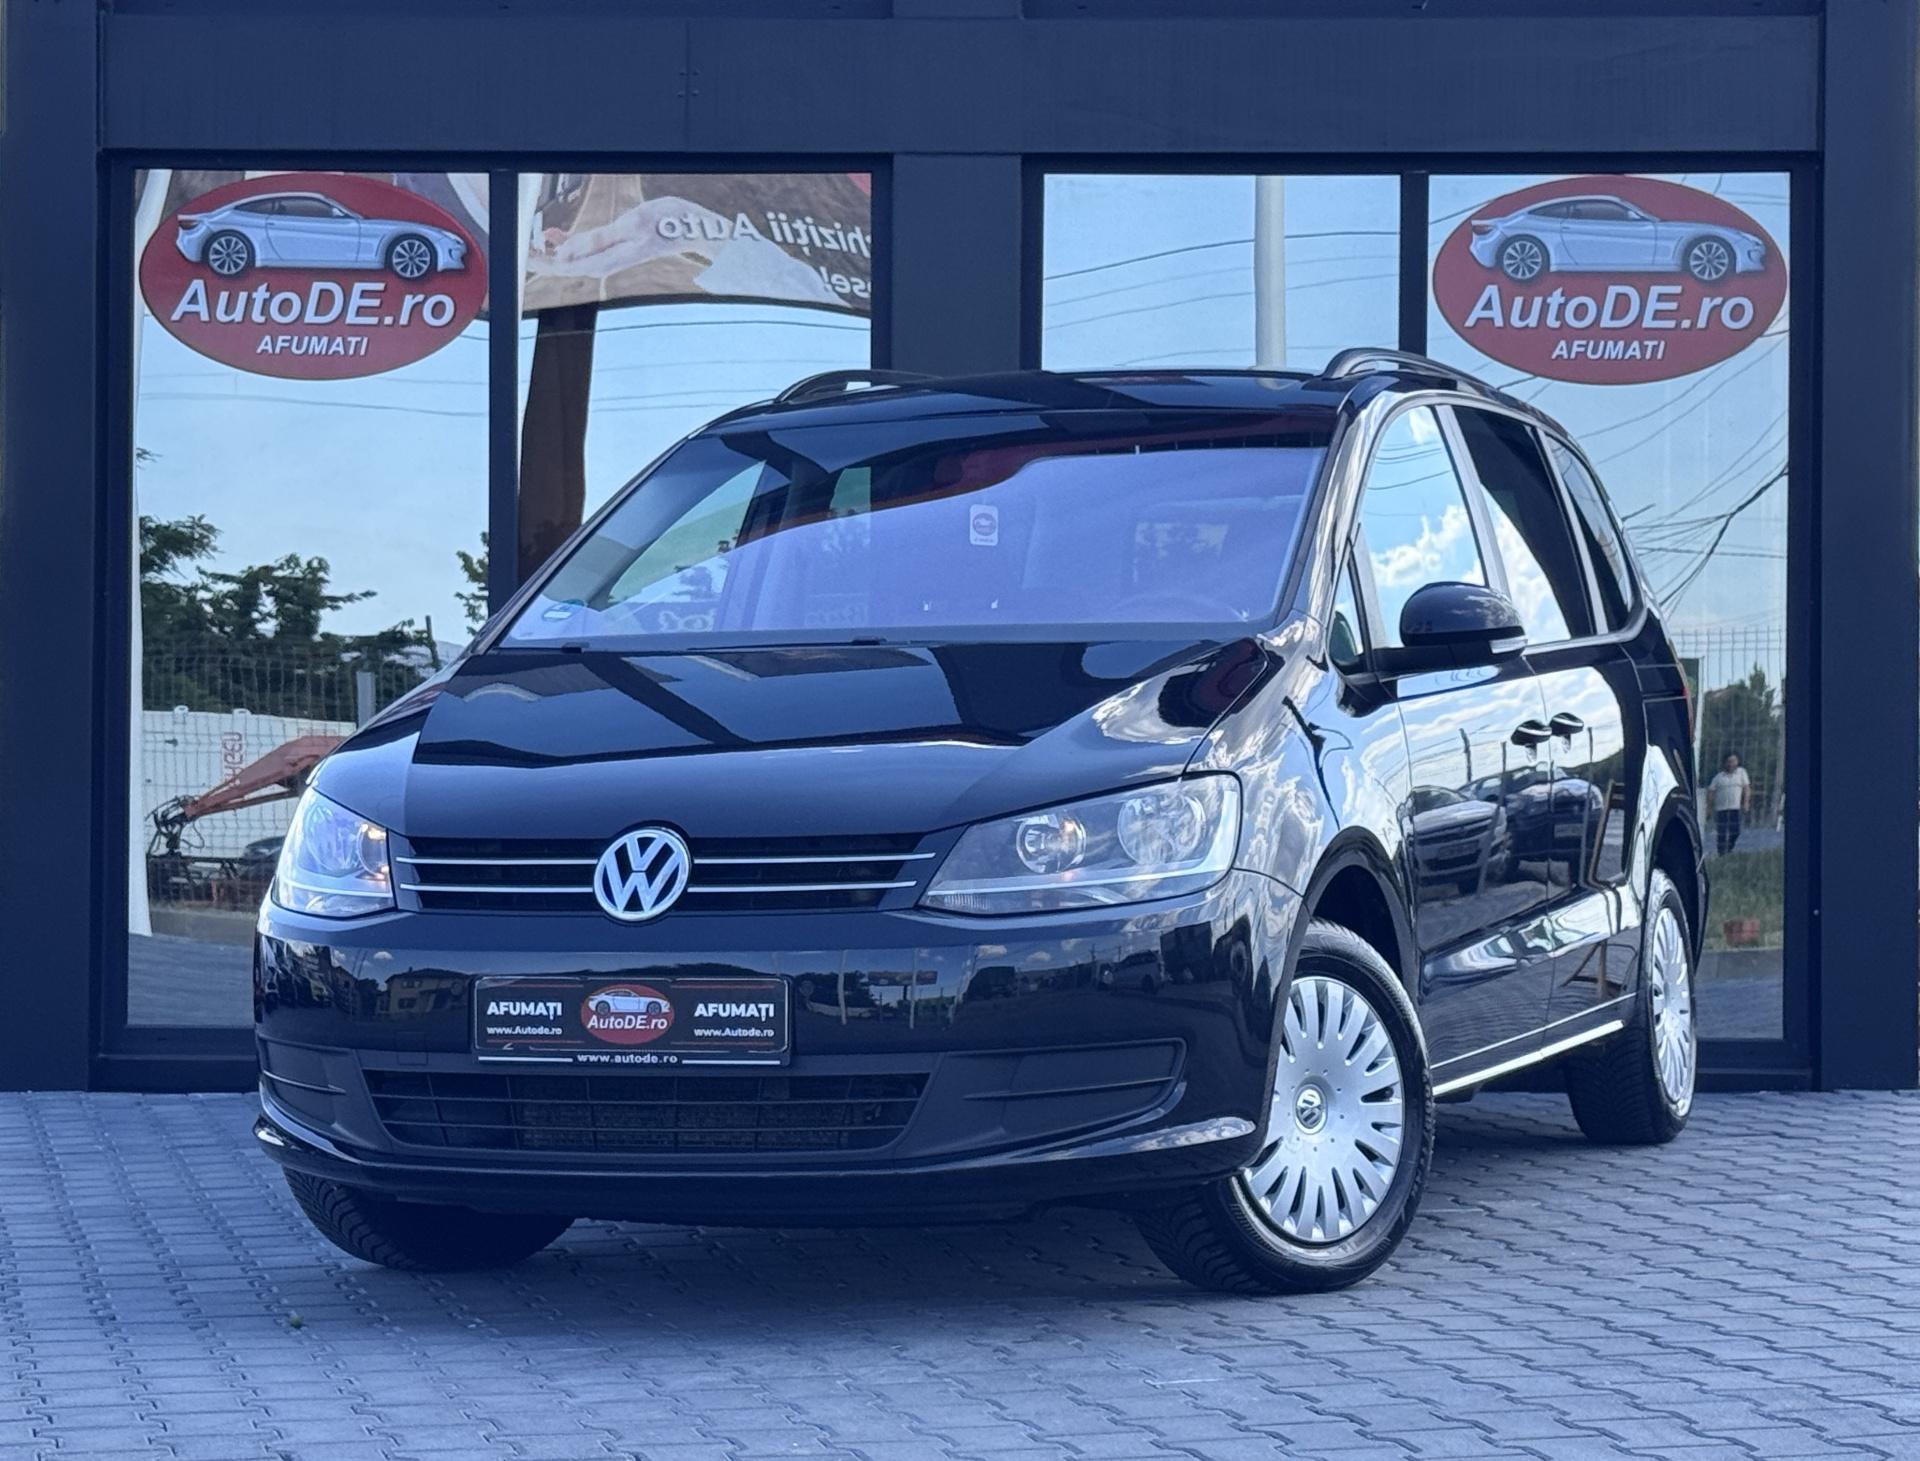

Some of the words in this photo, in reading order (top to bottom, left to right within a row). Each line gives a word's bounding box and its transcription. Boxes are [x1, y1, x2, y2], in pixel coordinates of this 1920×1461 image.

[171, 279, 456, 327] AutoDE.ro
[1464, 284, 1755, 331] AutoDE.ro
[256, 335, 369, 357] AFUMATI
[1551, 340, 1667, 361] AFUMATI
[596, 828, 689, 919] VW
[486, 1026, 563, 1035] www.Autode.ro
[587, 1015, 668, 1030] AutoDE.ro
[694, 1028, 775, 1037] www.Autode.ro
[577, 1053, 678, 1064] www.autode.ro
